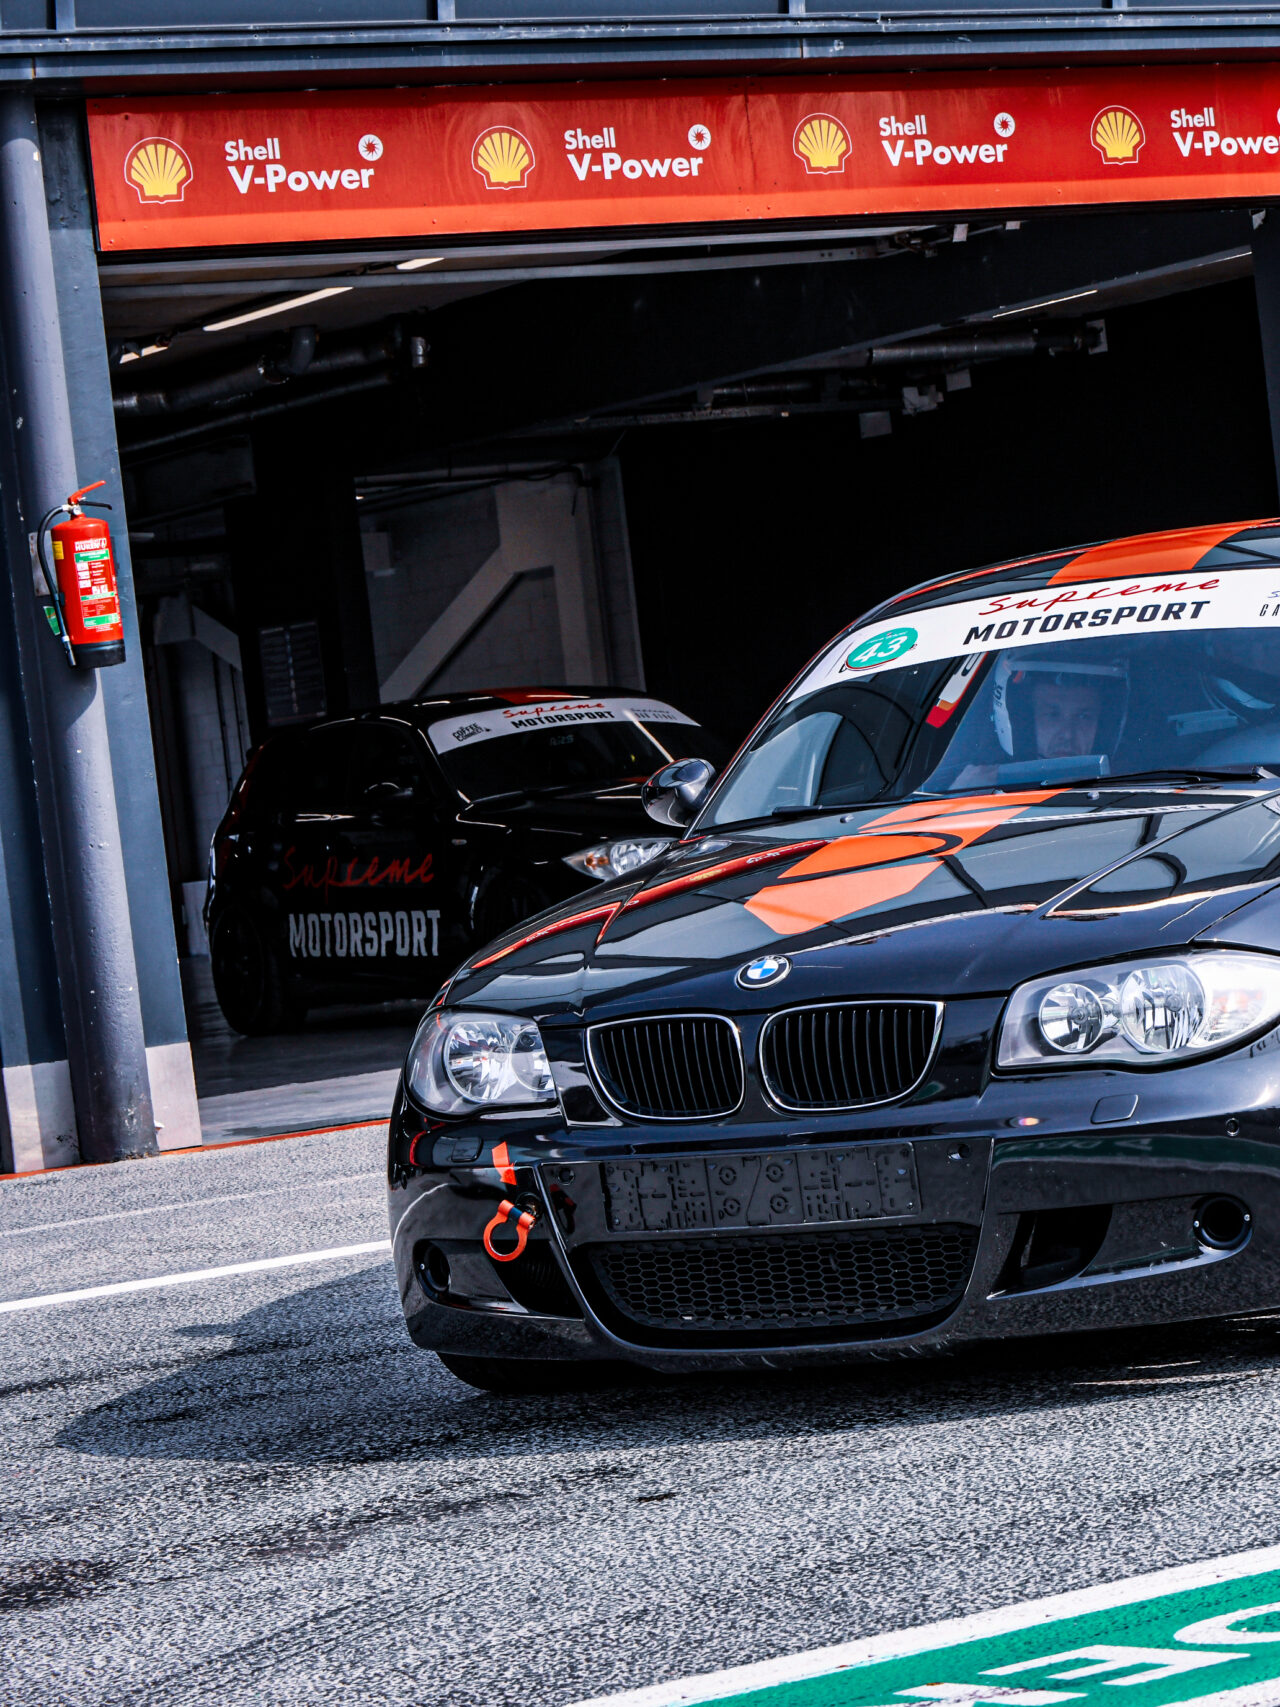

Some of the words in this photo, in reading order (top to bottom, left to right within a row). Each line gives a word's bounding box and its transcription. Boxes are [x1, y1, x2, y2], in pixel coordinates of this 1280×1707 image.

[879, 115, 927, 136] Shell
[1171, 107, 1215, 128] Shell
[225, 138, 280, 161] Shell
[564, 127, 616, 149] Shell
[882, 139, 1007, 166] V-Power
[228, 164, 374, 194] V-Power
[567, 152, 703, 181] V-Power
[979, 578, 1219, 616] Supreme
[963, 601, 1210, 645] MOTORSPORT
[853, 635, 908, 663] 43
[502, 702, 604, 718] Supreme
[511, 710, 616, 729] MOTORSPORT
[282, 846, 436, 906] Supreme
[288, 909, 441, 958] MOTORSPORT
